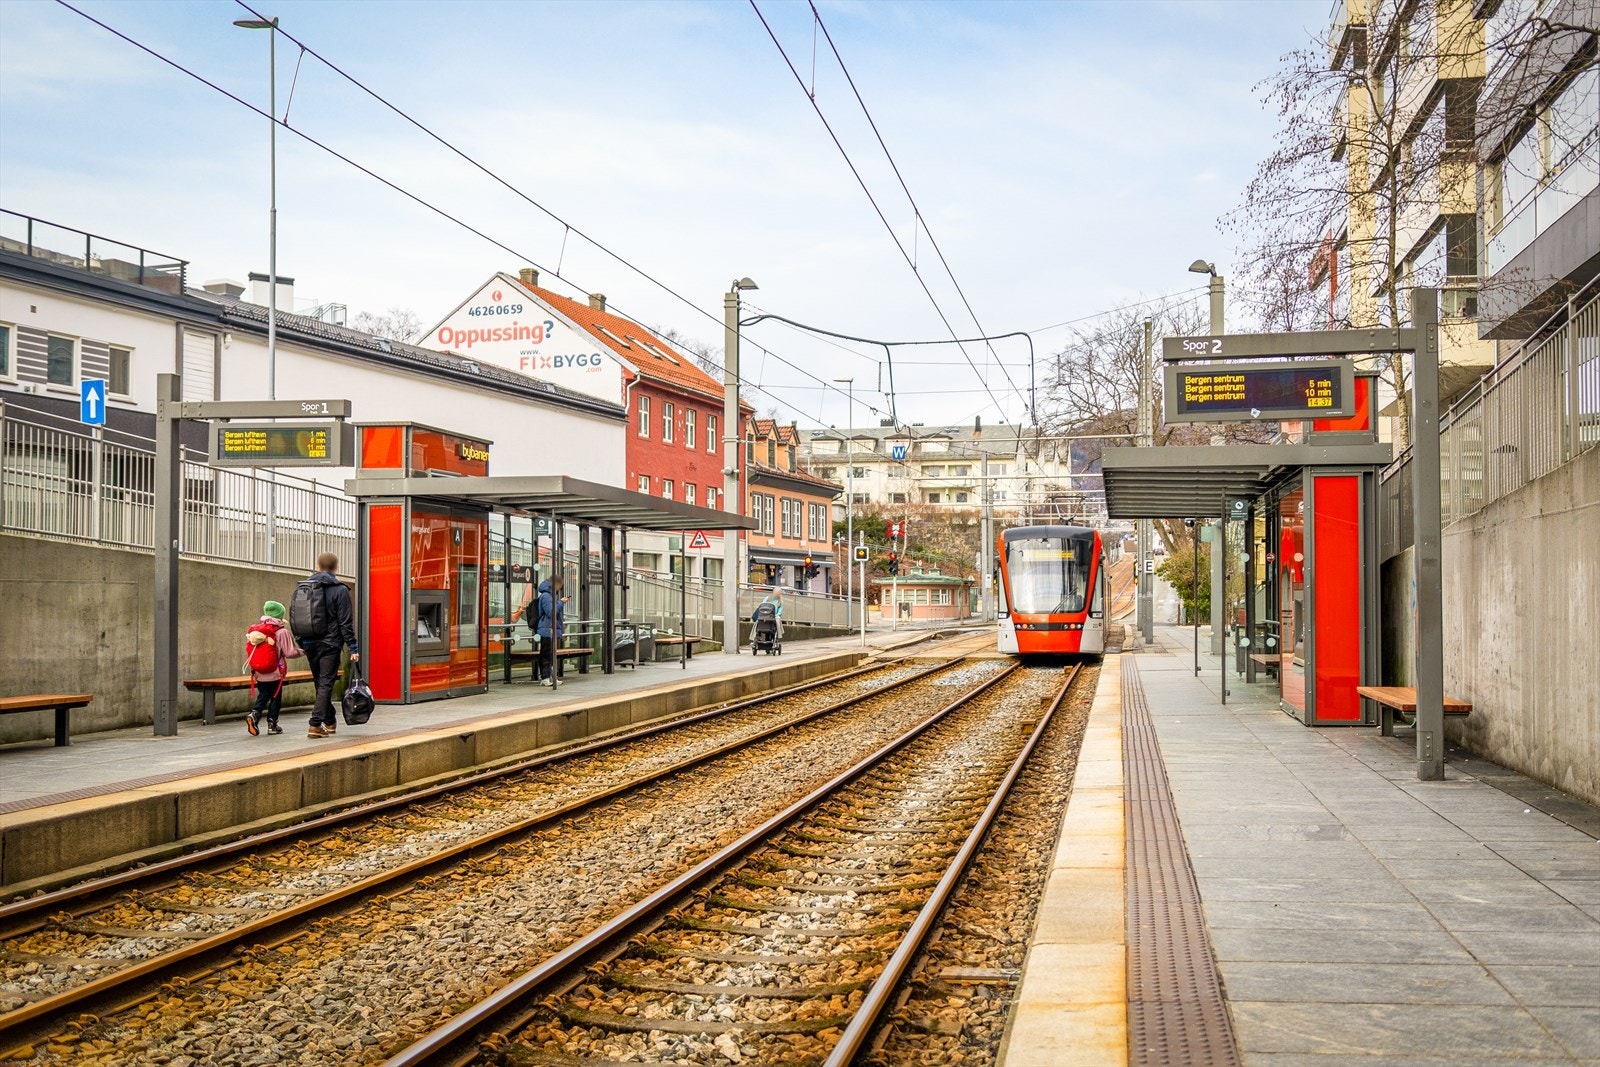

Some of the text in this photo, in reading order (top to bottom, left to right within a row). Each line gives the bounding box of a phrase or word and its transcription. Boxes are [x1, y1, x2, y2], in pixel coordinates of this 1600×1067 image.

[438, 320, 554, 348] Oppussing?
[1183, 340, 1222, 354] Spor 2
[519, 353, 602, 370] FIXBYGG
[1185, 375, 1245, 386] Bergen sentrum
[1185, 379, 1331, 394] Bergen sentrum 5 min
[1185, 388, 1331, 403] Bergen sentrum 10 min
[301, 402, 329, 414] Spor 1
[462, 443, 491, 461] bybanen
[893, 447, 905, 458] W
[455, 530, 461, 542] A
[1145, 562, 1153, 572] E
